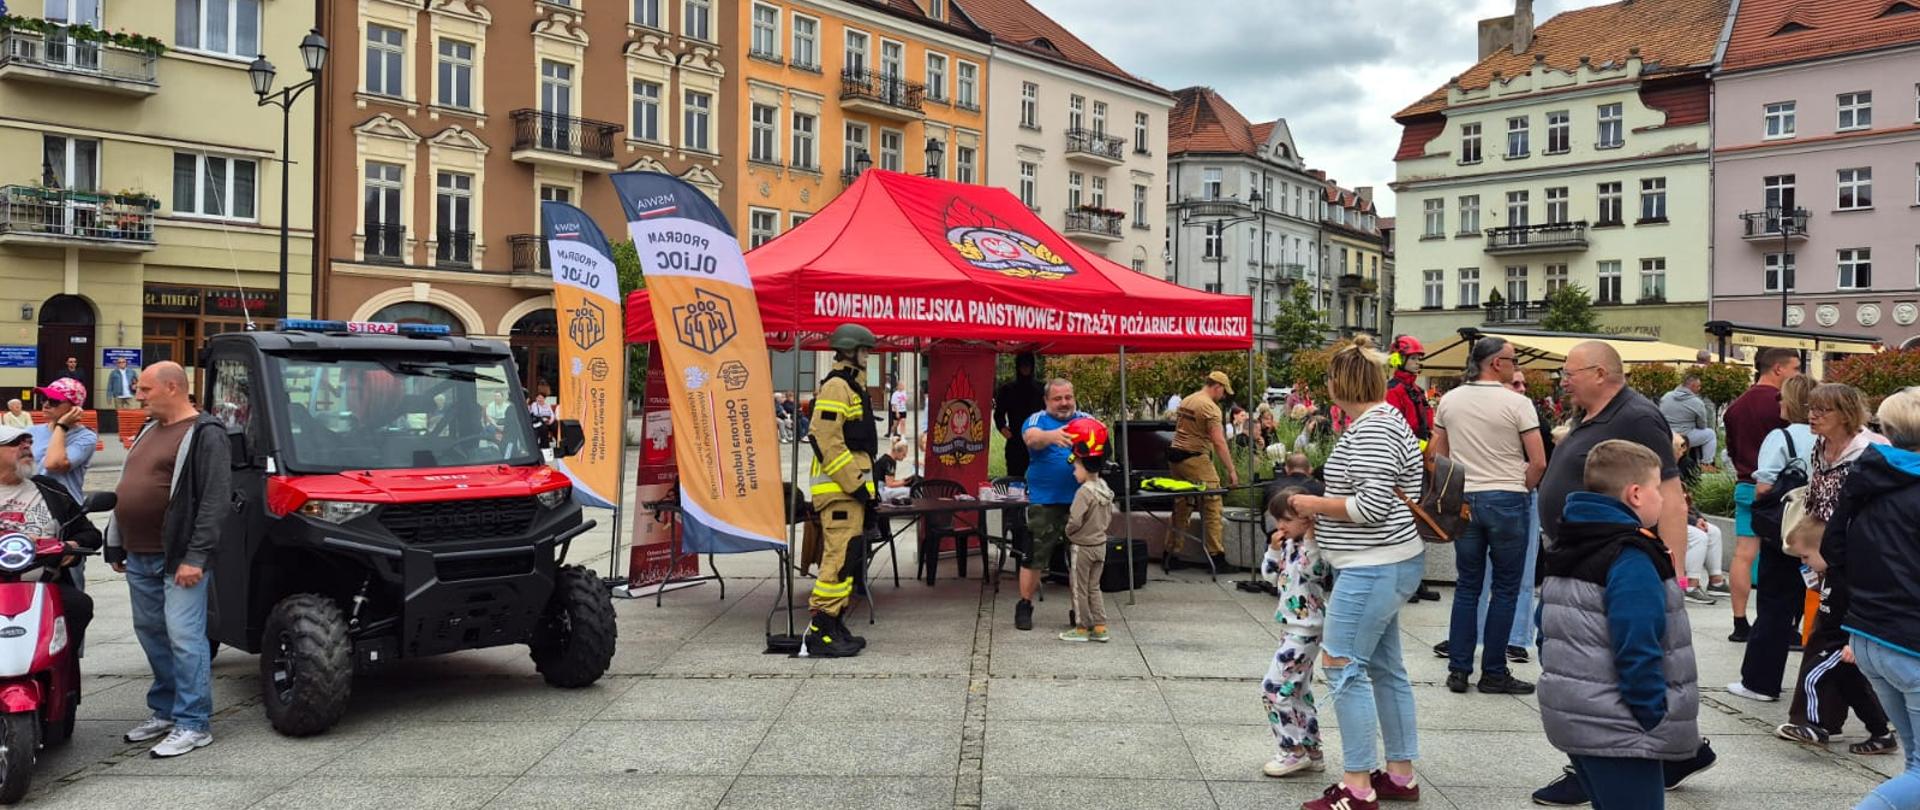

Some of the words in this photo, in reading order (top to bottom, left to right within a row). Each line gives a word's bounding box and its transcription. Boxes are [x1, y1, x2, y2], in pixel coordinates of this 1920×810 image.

[814, 291, 894, 320] KOMENDA
[898, 296, 965, 322] MIEJSKA
[968, 296, 1064, 331] PAŃSTWOWEJ
[1067, 308, 1116, 335] STRAŻY
[1120, 310, 1183, 336] POŻARNEJ
[1185, 316, 1198, 336] W
[1198, 316, 1247, 337] KALISZU
[419, 511, 514, 528] POLARIS
